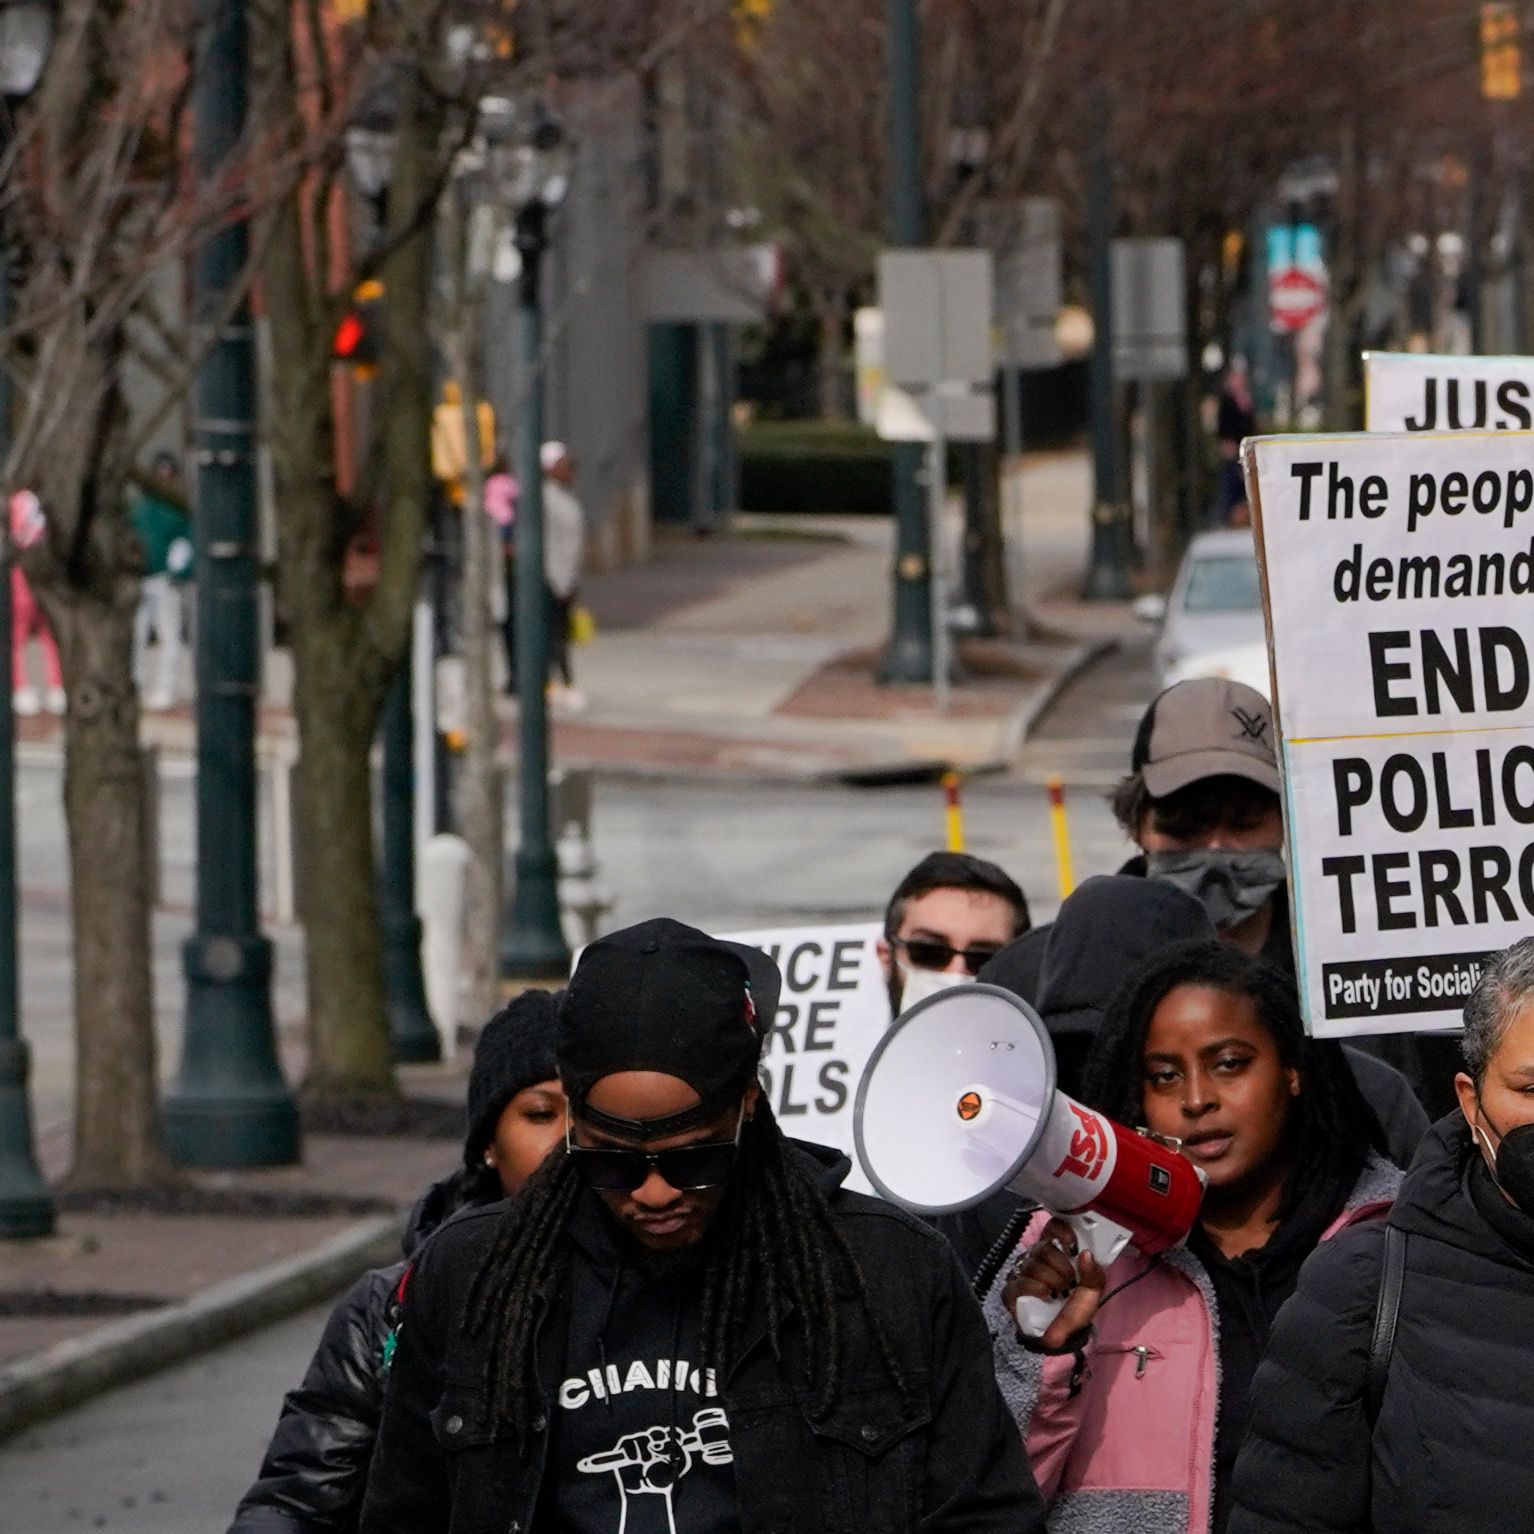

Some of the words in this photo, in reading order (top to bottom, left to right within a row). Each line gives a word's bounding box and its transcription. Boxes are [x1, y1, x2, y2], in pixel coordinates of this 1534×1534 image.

[1291, 461, 1388, 521] The
[1368, 626, 1530, 717] END
[1328, 971, 1381, 1012] Party
[1385, 967, 1413, 1000] for
